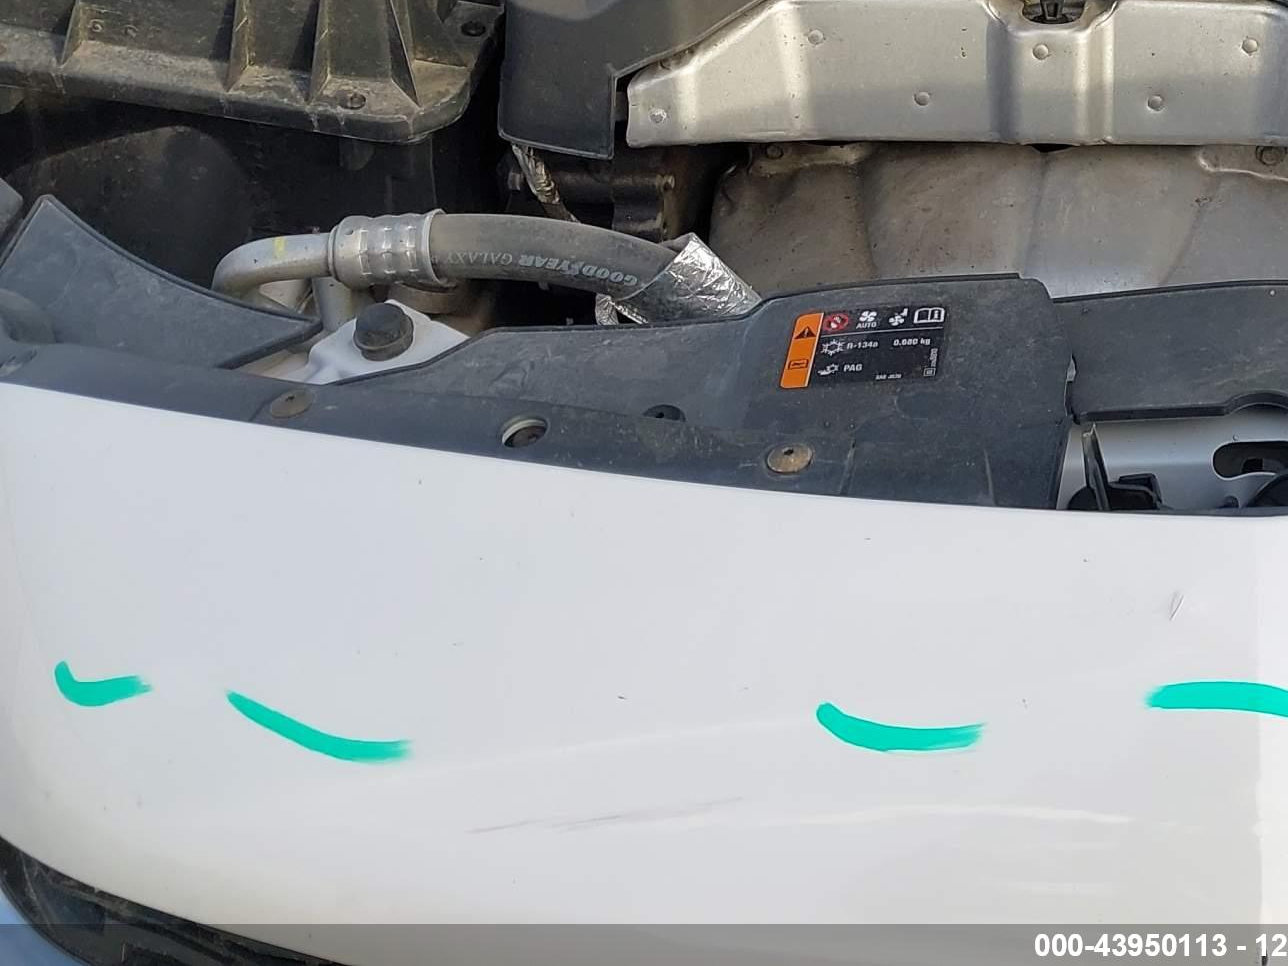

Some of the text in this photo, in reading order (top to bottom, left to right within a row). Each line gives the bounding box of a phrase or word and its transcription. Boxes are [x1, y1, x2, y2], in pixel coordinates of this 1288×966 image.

[445, 251, 514, 268] GALAXY
[518, 253, 639, 287] GOODYEAR
[855, 321, 877, 330] AUTO
[846, 340, 879, 350] R-134a
[843, 363, 863, 372] PAG
